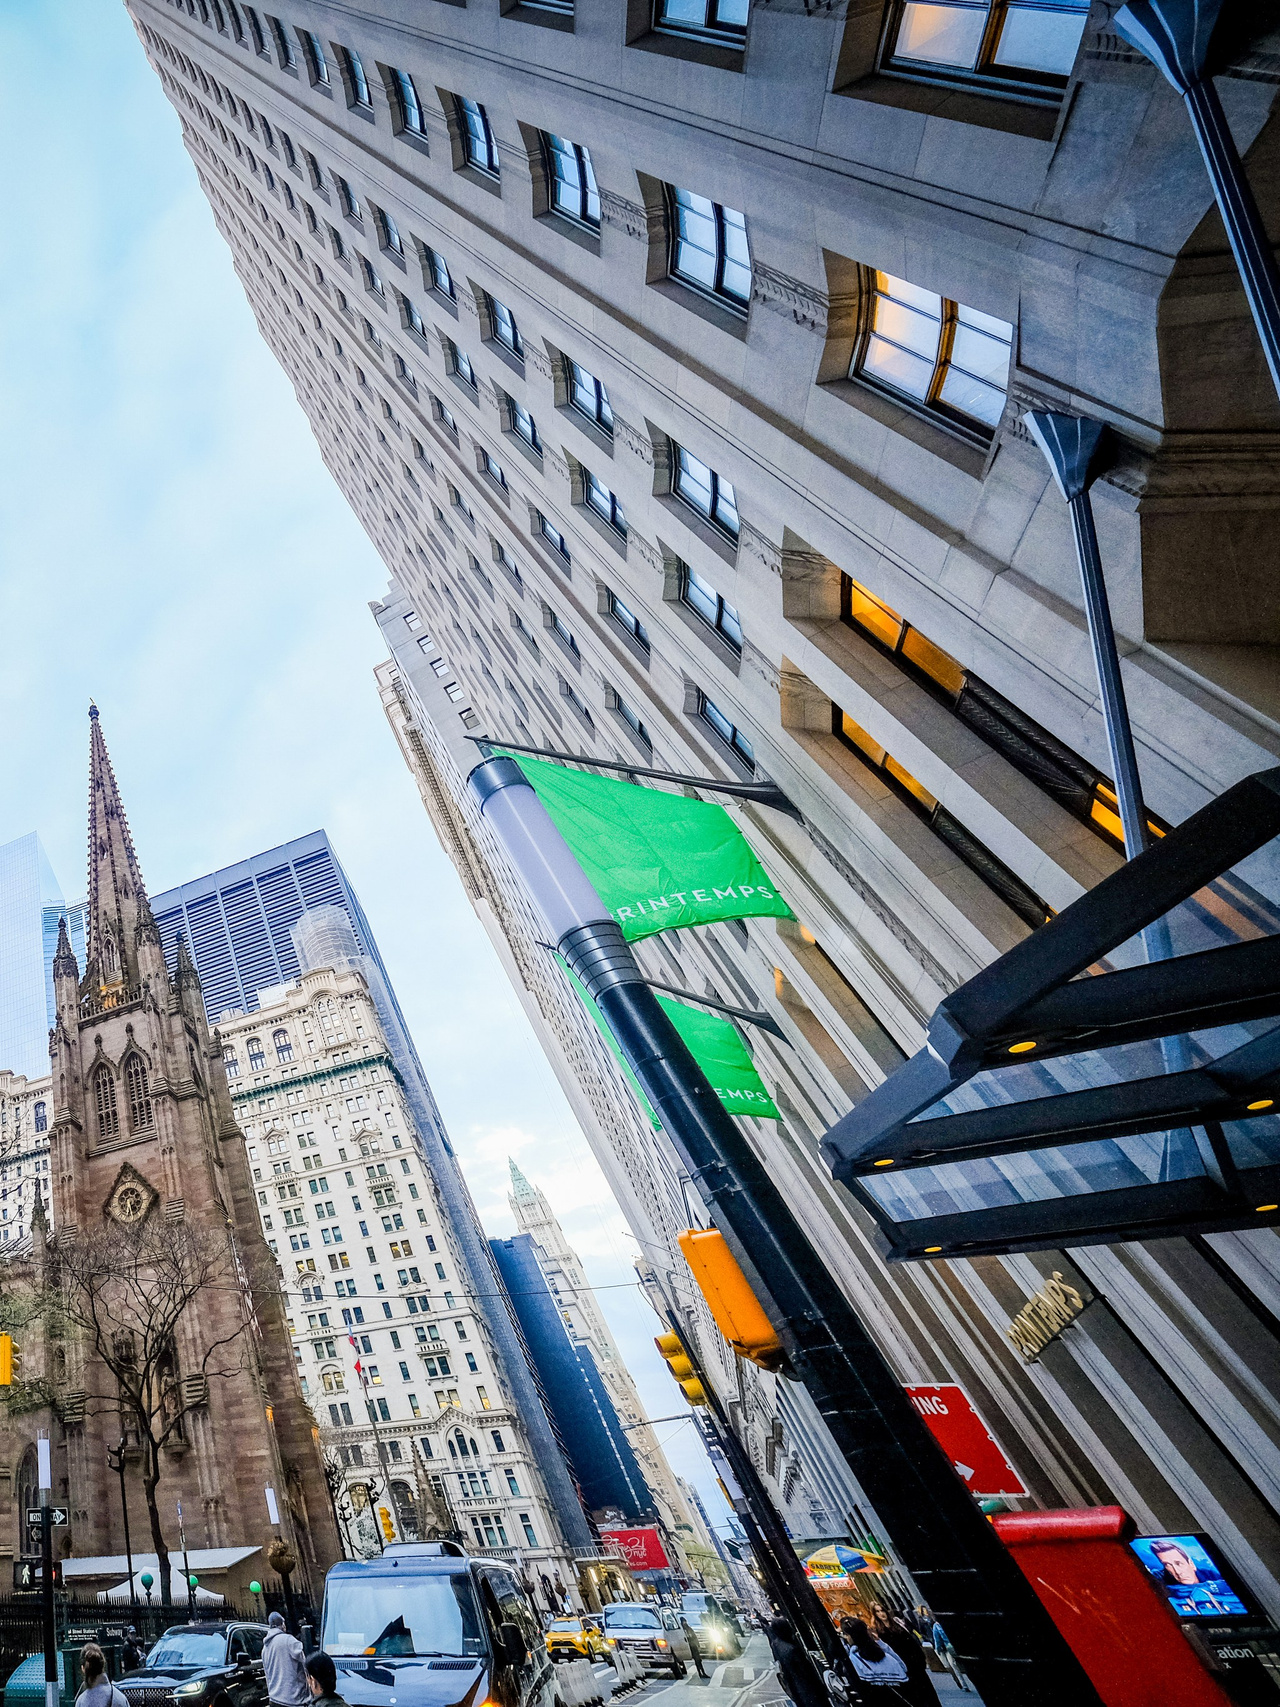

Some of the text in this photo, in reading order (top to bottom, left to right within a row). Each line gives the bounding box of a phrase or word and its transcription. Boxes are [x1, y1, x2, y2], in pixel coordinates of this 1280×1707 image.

[611, 885, 774, 922] RINTEMPS
[1004, 1271, 1085, 1363] PRINTEMPS
[911, 1396, 949, 1415] ING
[106, 1627, 123, 1640] Subway
[1216, 1646, 1255, 1659] ation
